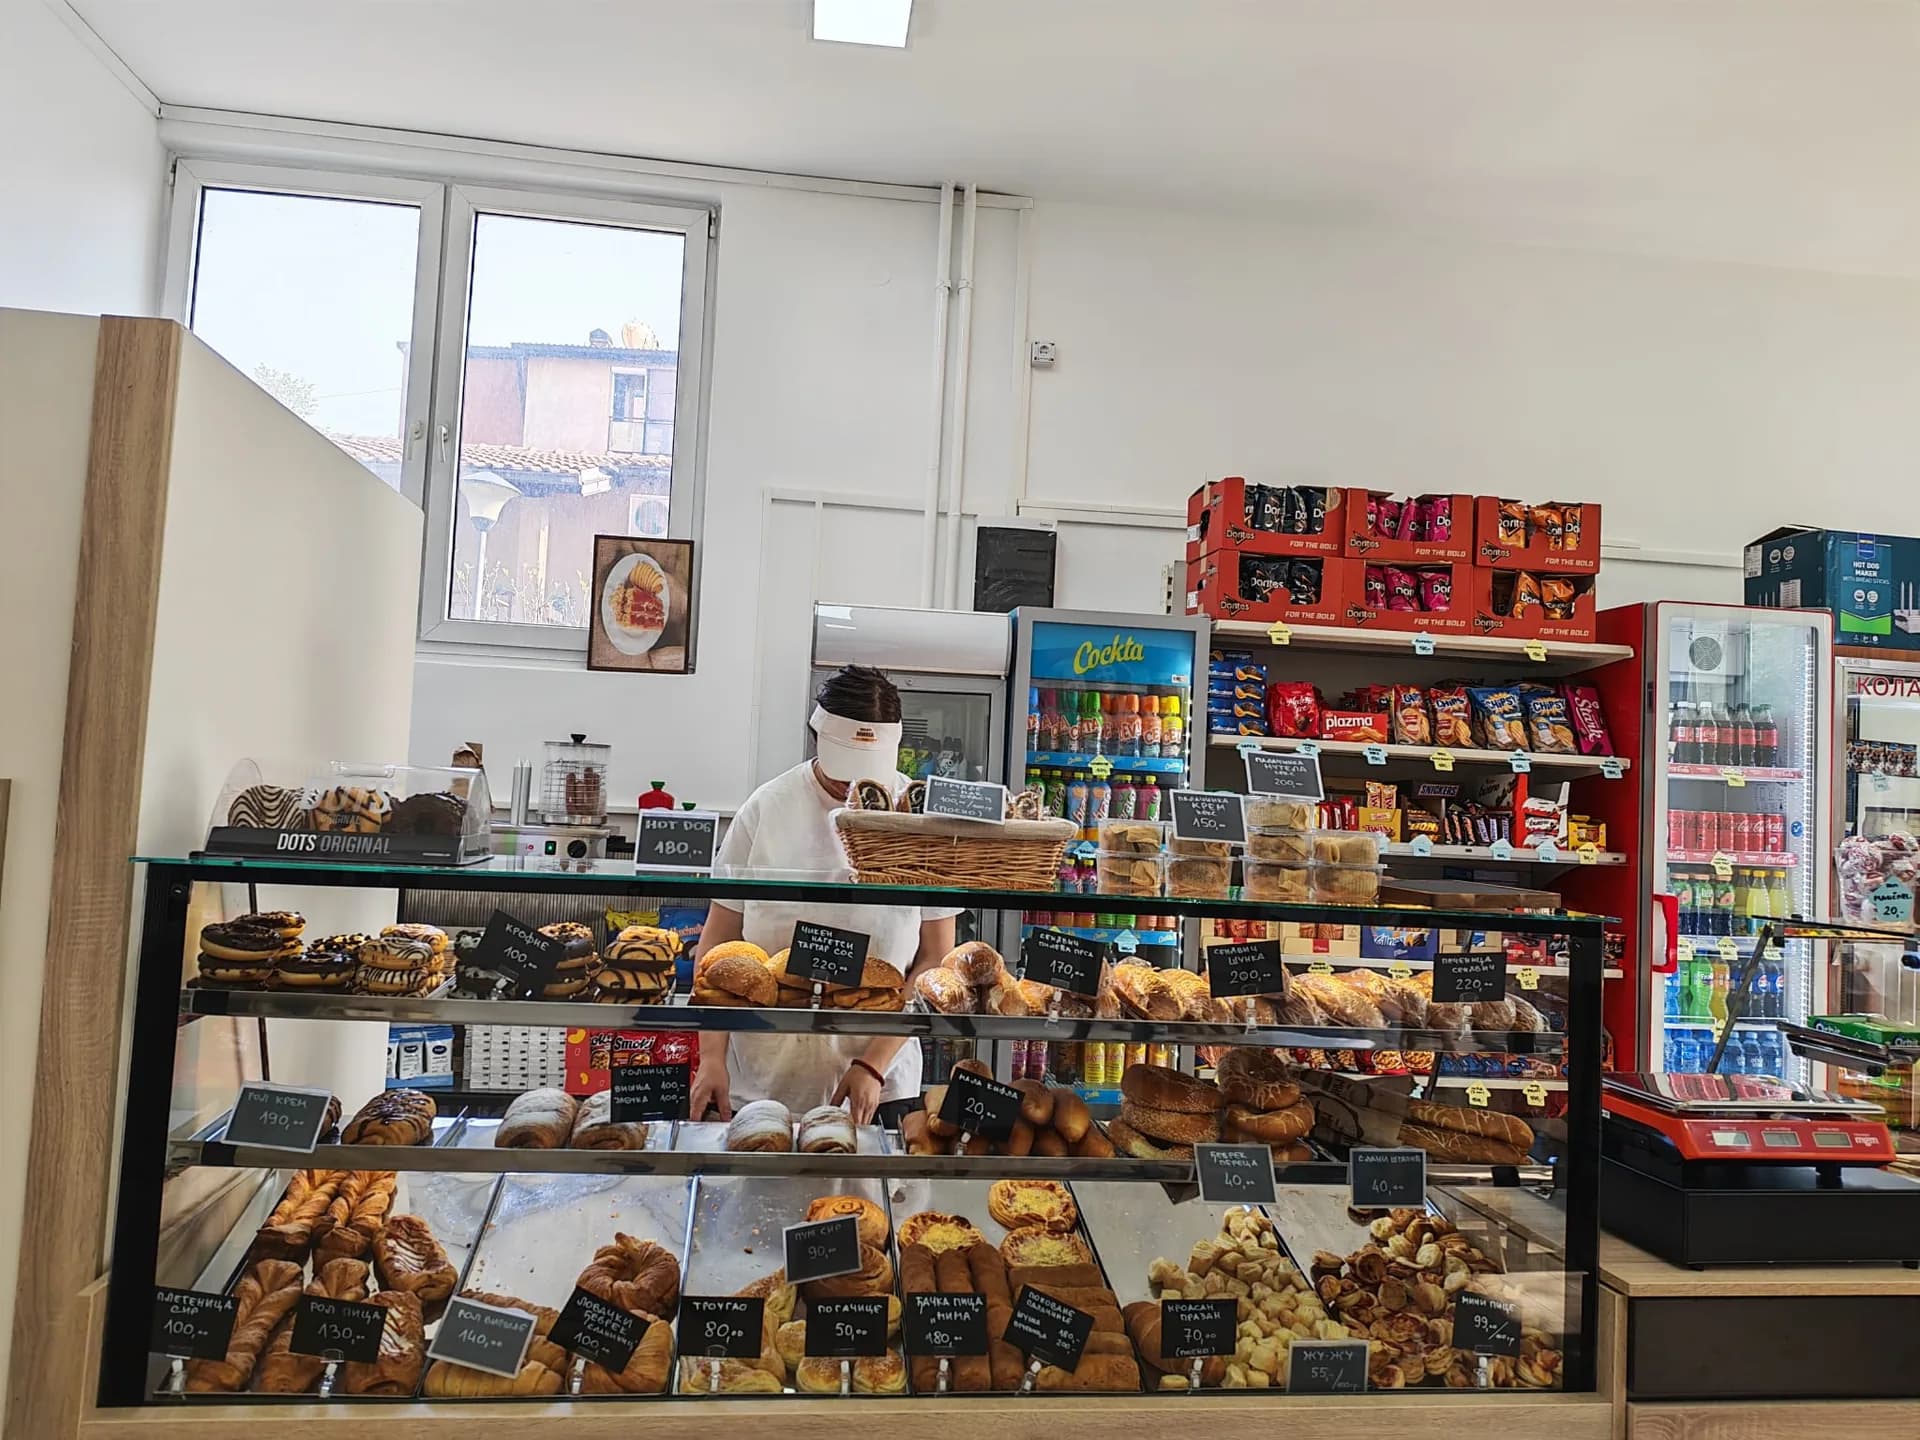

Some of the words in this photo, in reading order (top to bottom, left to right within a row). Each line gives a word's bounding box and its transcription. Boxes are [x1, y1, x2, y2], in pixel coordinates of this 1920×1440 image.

[1226, 529, 1255, 540] Doritos
[1290, 540, 1304, 548] FOR
[1350, 538, 1380, 548] Doritos
[1481, 547, 1510, 557] Doritos
[1855, 569, 1878, 577] MAKER
[1220, 601, 1249, 611] Doritos
[1347, 609, 1377, 618] Doritos
[1474, 618, 1503, 628] Doritos
[1073, 634, 1144, 675] Cockta
[1532, 698, 1565, 711] CHIPSY
[1326, 716, 1373, 730] plazma
[1264, 764, 1307, 773] НУТЕЛА
[1422, 785, 1457, 796] SNICKERS
[1192, 802, 1225, 811] КРЕМ
[645, 819, 677, 831] HOT
[683, 820, 712, 833] DOG
[277, 833, 316, 851] DOTS
[320, 836, 391, 855] ORIGINAL
[801, 925, 833, 938] ЧИКЕН
[505, 923, 550, 952] КРОФНЕ
[798, 940, 829, 953] ТАРТАР
[833, 948, 854, 959] СОС
[1213, 945, 1258, 955] СЕНДВИЧ
[1228, 953, 1265, 965] ШУНКА
[1441, 956, 1492, 966] ПЕЧЕНИЦА
[1451, 964, 1495, 974] СЕНДВИЧ
[614, 1035, 656, 1051] Smoki
[275, 1096, 307, 1109] КРЕМ
[820, 1224, 842, 1237] СИР
[157, 1292, 234, 1310] ПЛЕТЕНИЦА
[692, 1301, 748, 1312] ТРОУГАО
[953, 1296, 984, 1311] ПИЦА
[1462, 1296, 1487, 1307] МИНИ
[1490, 1300, 1517, 1315] ПИЦЕ
[170, 1305, 199, 1315] СИР
[310, 1302, 336, 1314] РОЛ
[342, 1307, 382, 1324] ПИЦА
[576, 1296, 633, 1329] ЛОВАЧКИ
[818, 1303, 883, 1315] ПОГАЧИЦЕ
[1167, 1303, 1214, 1313] КРОАСАН
[1180, 1312, 1222, 1321] ПРАЗАН
[1303, 1350, 1354, 1361] ЖУ-ЖУ
